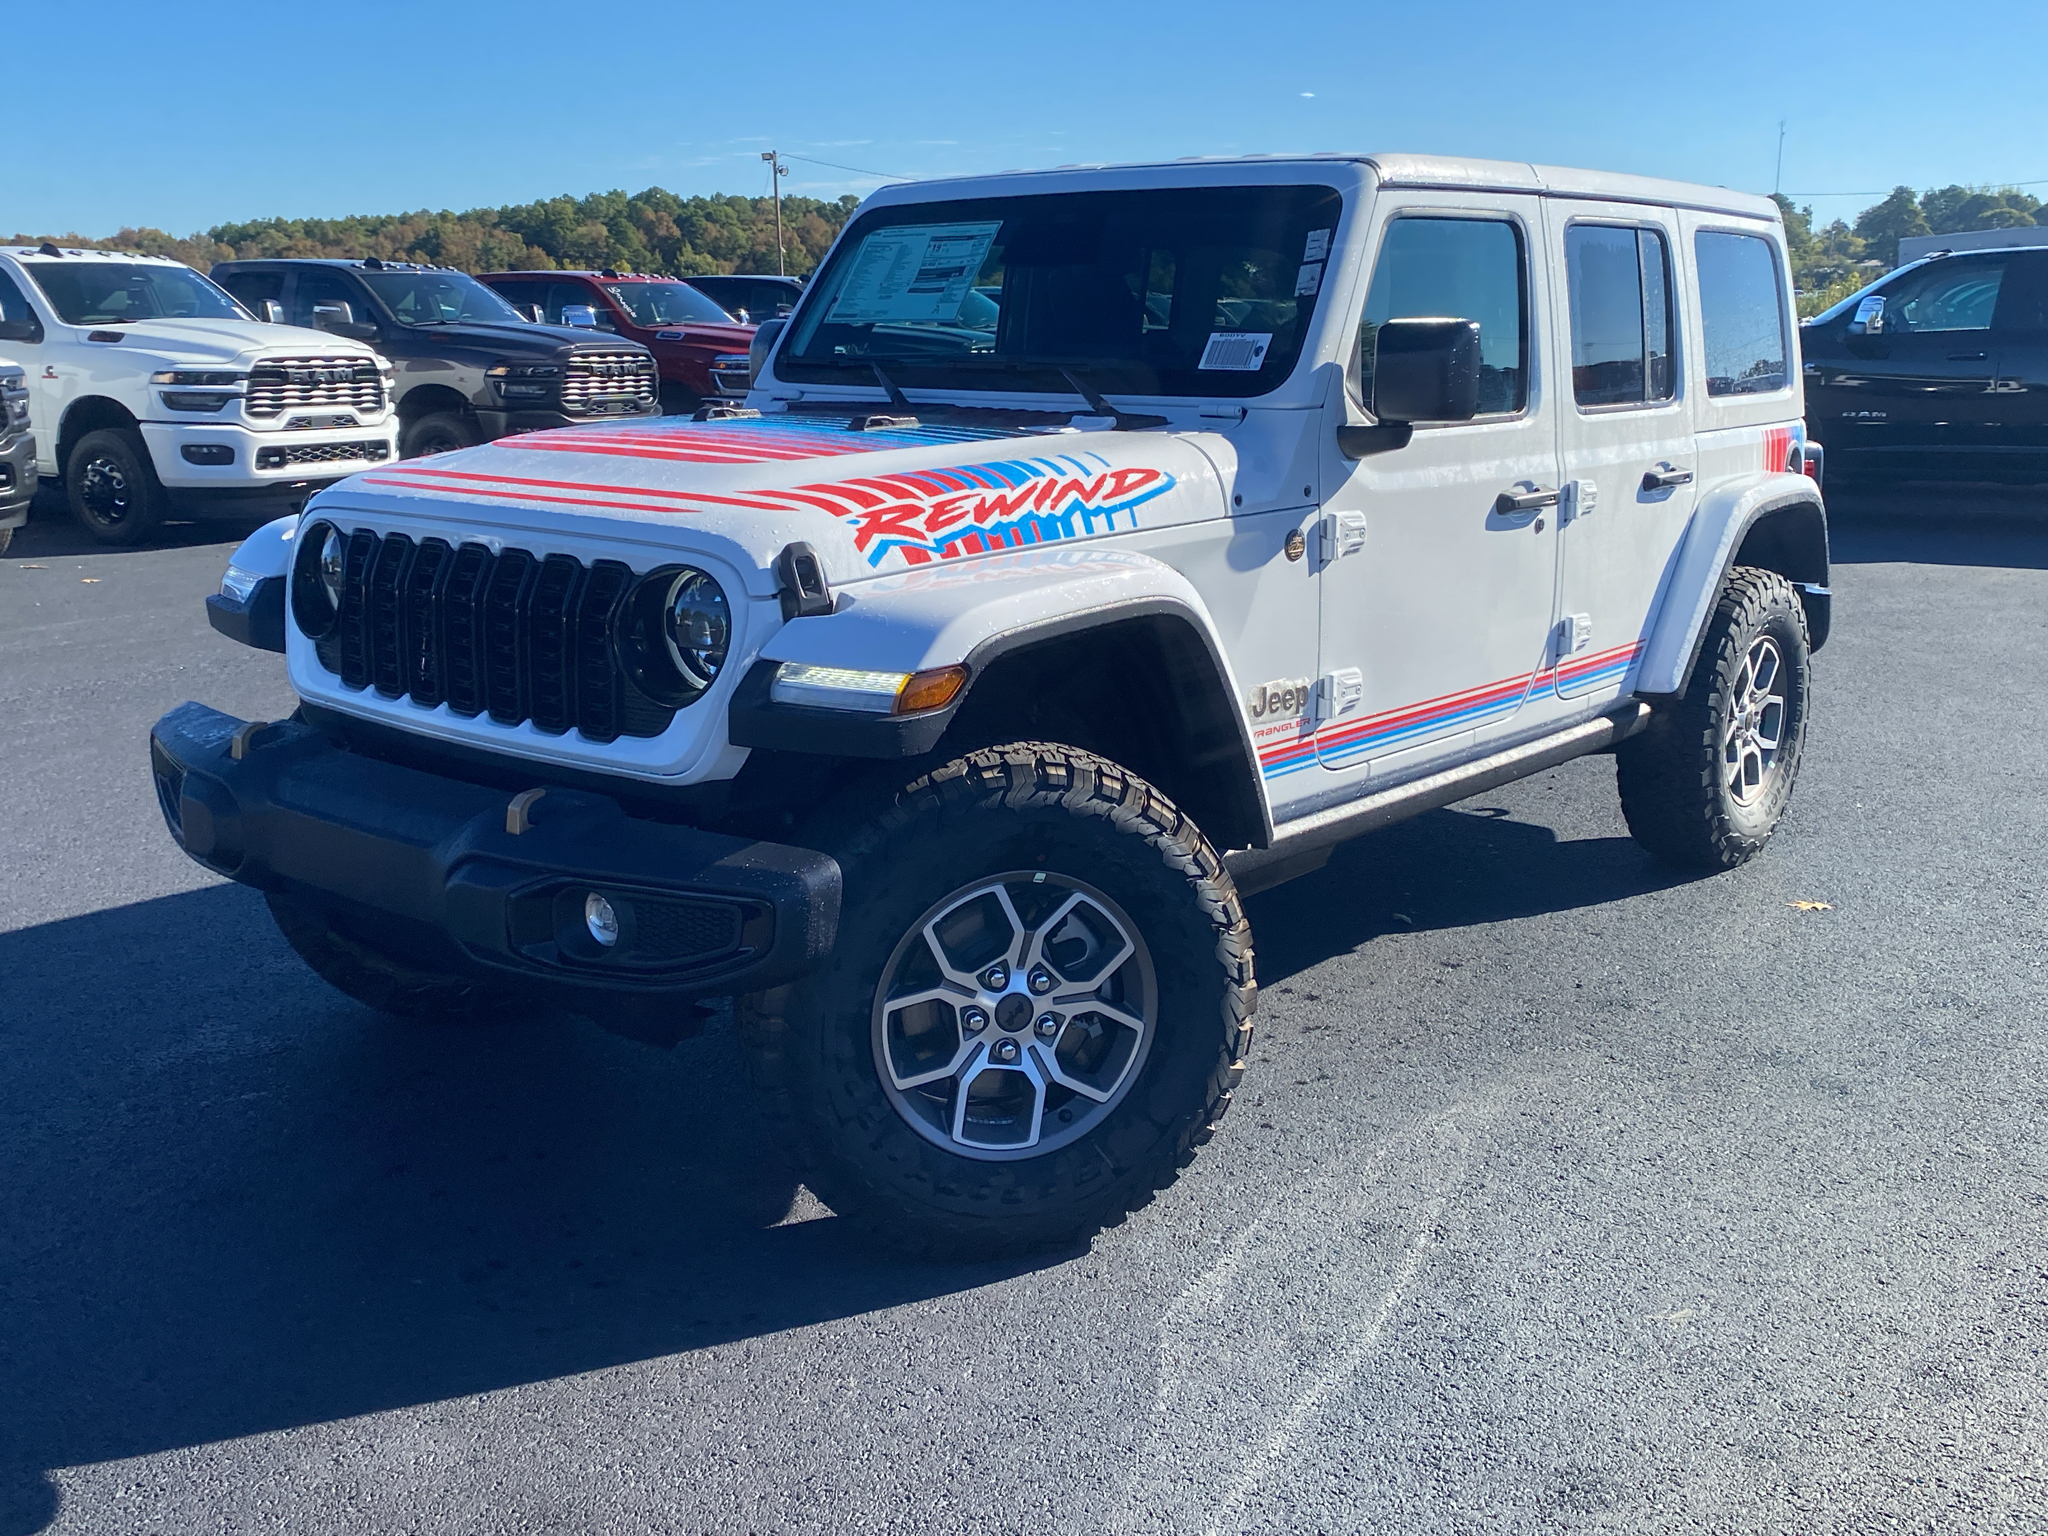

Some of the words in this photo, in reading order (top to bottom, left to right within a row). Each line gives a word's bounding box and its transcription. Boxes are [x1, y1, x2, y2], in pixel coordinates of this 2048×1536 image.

[287, 368, 354, 382] RAM
[591, 364, 637, 375] RAM
[853, 468, 1162, 553] REWIND
[1252, 685, 1309, 718] Jeep
[1253, 718, 1311, 739] RANGLER
